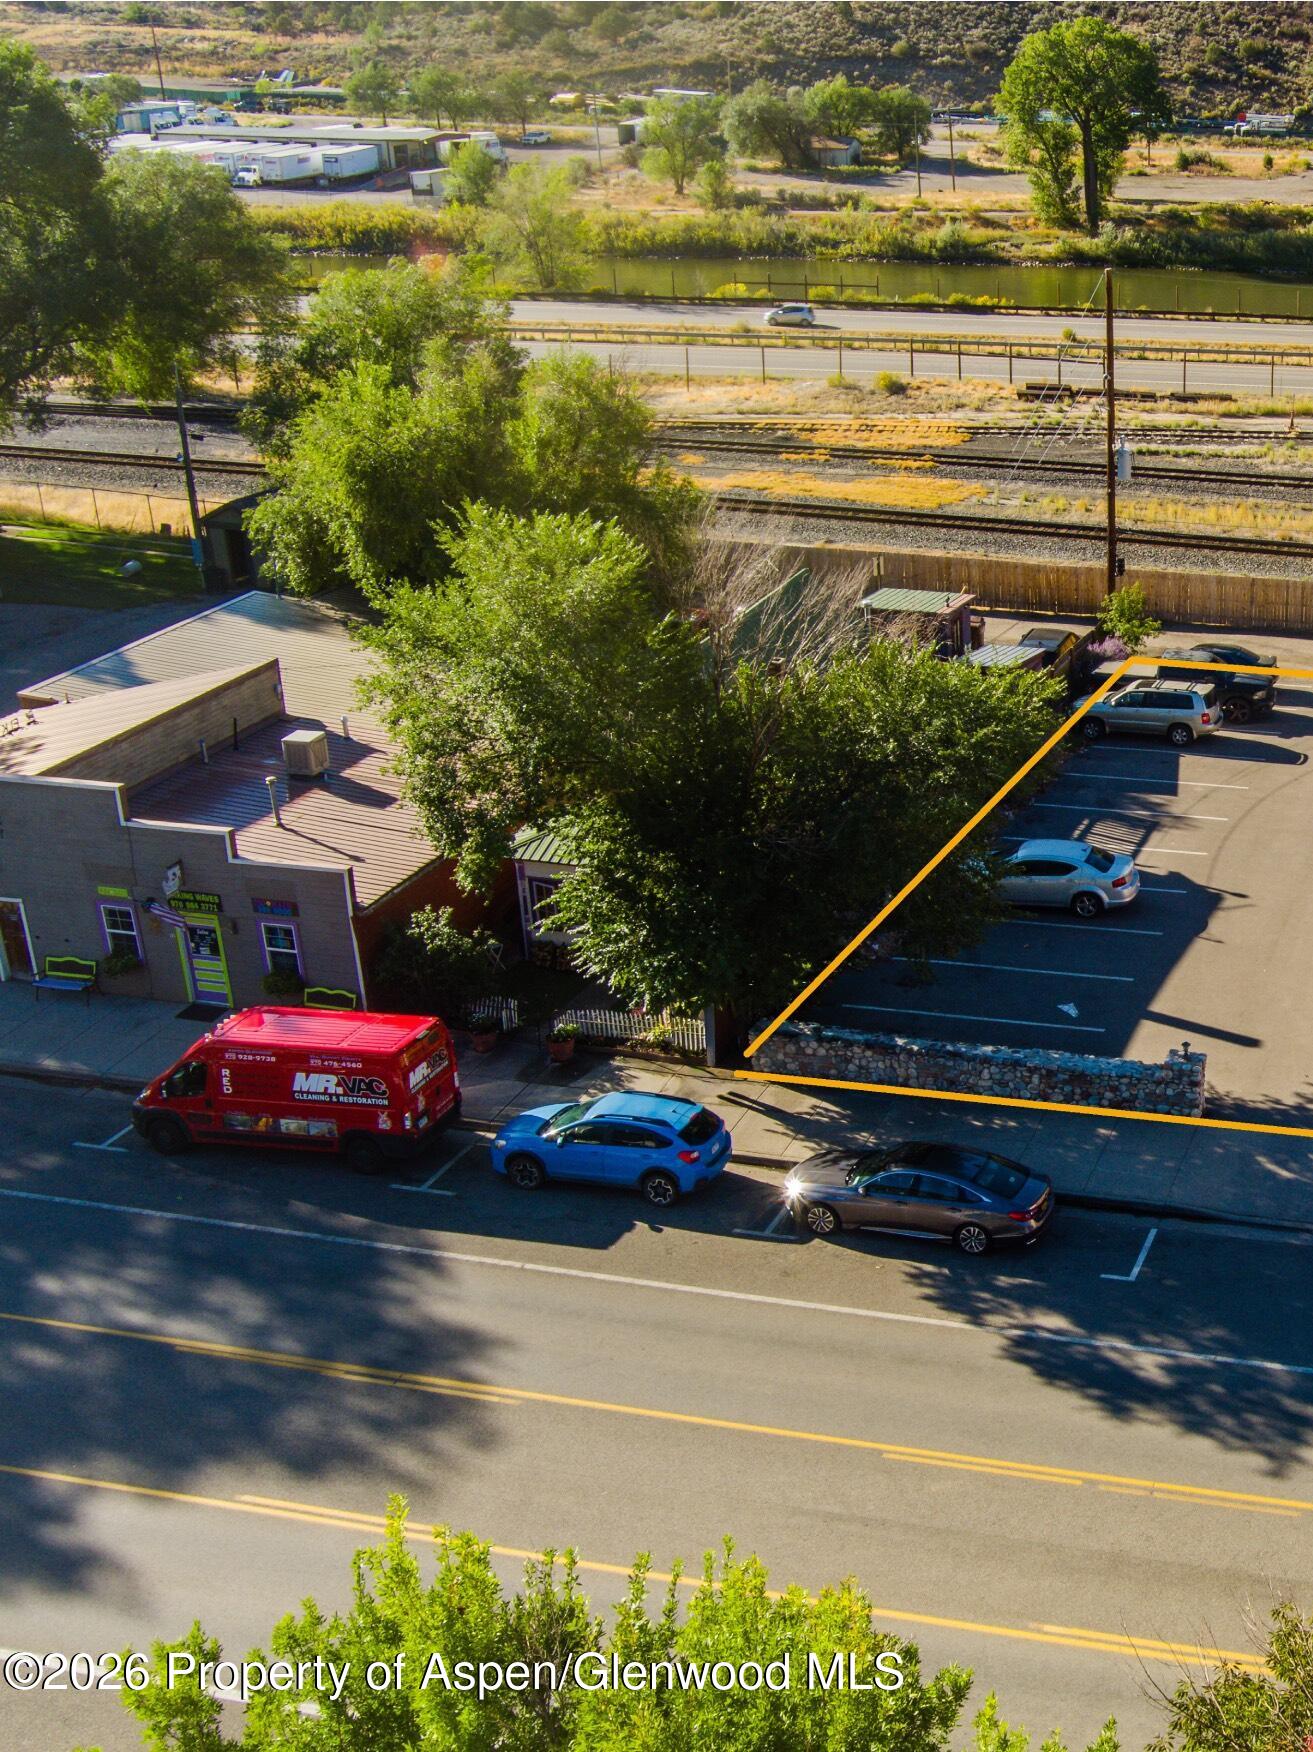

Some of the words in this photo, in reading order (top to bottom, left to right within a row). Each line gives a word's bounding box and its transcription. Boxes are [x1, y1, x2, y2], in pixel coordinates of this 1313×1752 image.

[221, 1068, 233, 1094] RED
[294, 1093, 330, 1102] CLEANING
[339, 1096, 389, 1106] RESTORATION
